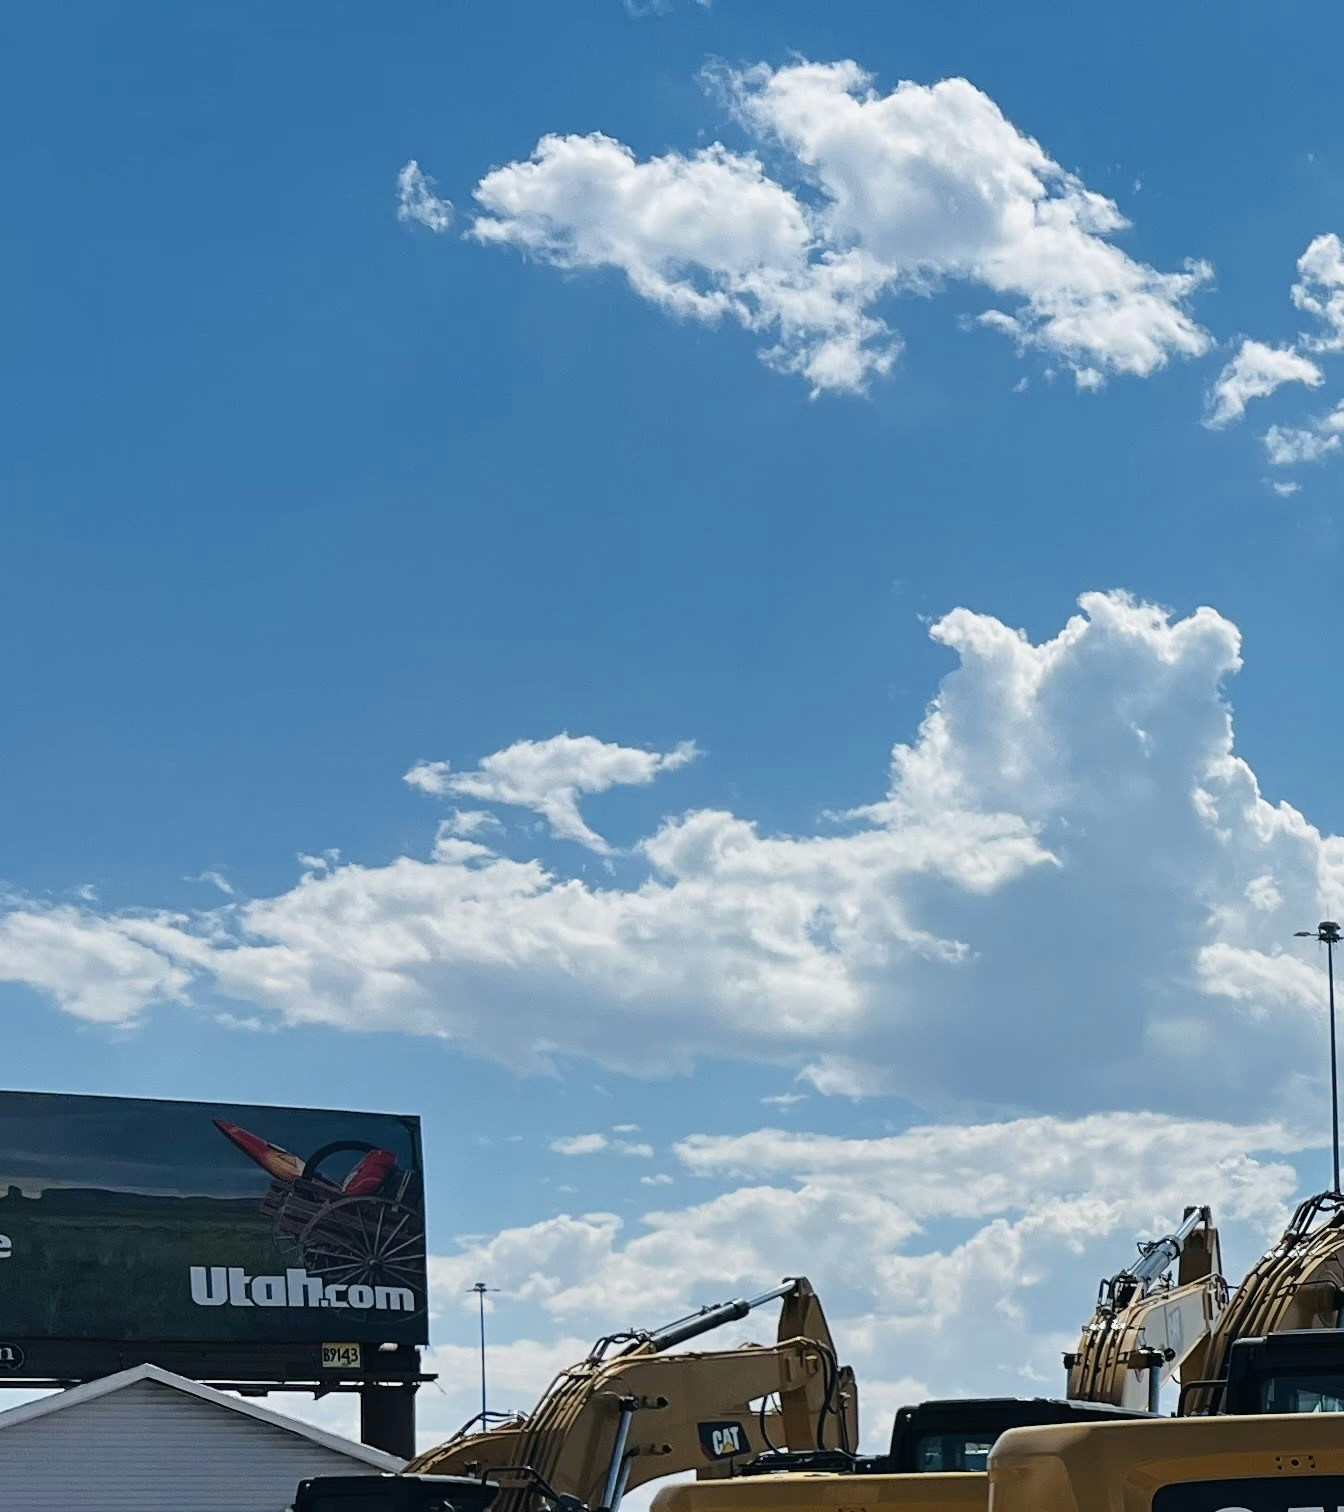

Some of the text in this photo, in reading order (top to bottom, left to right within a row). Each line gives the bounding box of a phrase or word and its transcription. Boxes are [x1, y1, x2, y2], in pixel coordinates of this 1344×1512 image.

[189, 1265, 415, 1312] Utah.com
[323, 1347, 359, 1364] B9143
[712, 1426, 740, 1456] CAT
